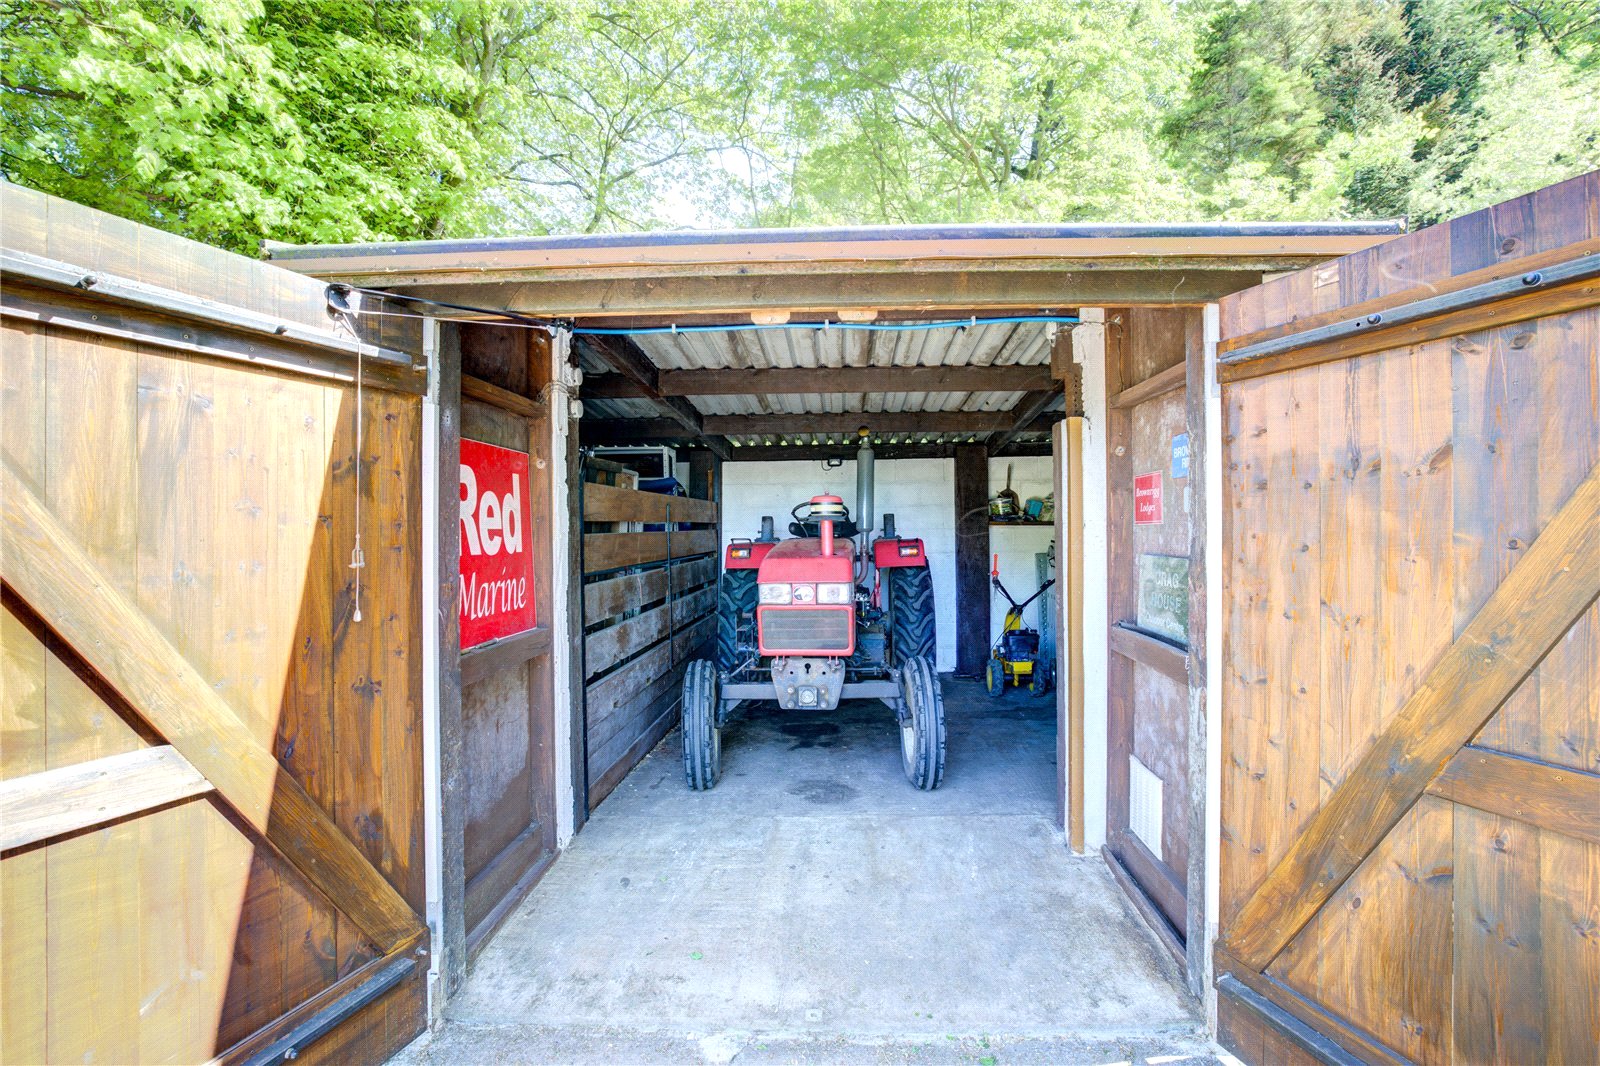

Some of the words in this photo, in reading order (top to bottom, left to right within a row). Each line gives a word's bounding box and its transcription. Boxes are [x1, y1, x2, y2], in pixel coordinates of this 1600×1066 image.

[460, 464, 523, 557] Red
[1140, 501, 1156, 516] Lodges
[1155, 571, 1180, 589] CRAG
[459, 567, 527, 621] Marine
[1151, 592, 1182, 614] HOUSE
